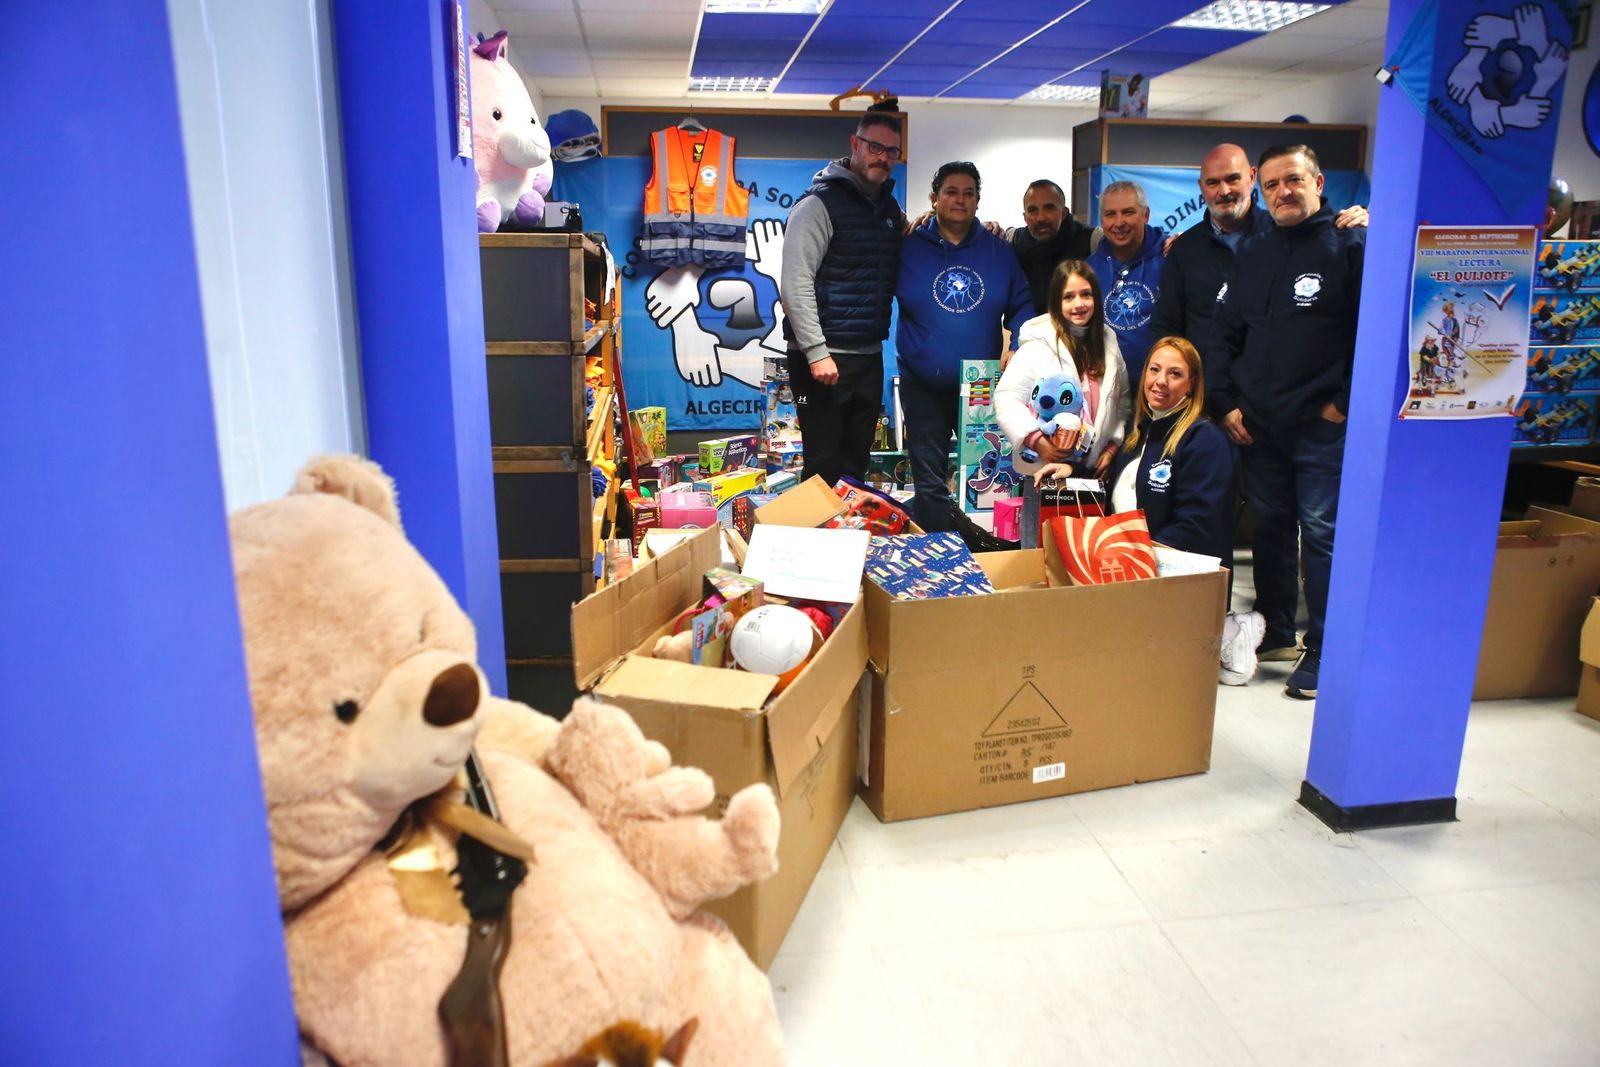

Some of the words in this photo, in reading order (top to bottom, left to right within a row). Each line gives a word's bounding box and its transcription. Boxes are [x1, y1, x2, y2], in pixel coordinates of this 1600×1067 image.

[1435, 248, 1470, 256] MARATÓN
[685, 400, 761, 415] ALGECIR
[979, 775, 998, 785] ITEM
[999, 771, 1028, 782] BARCODE
